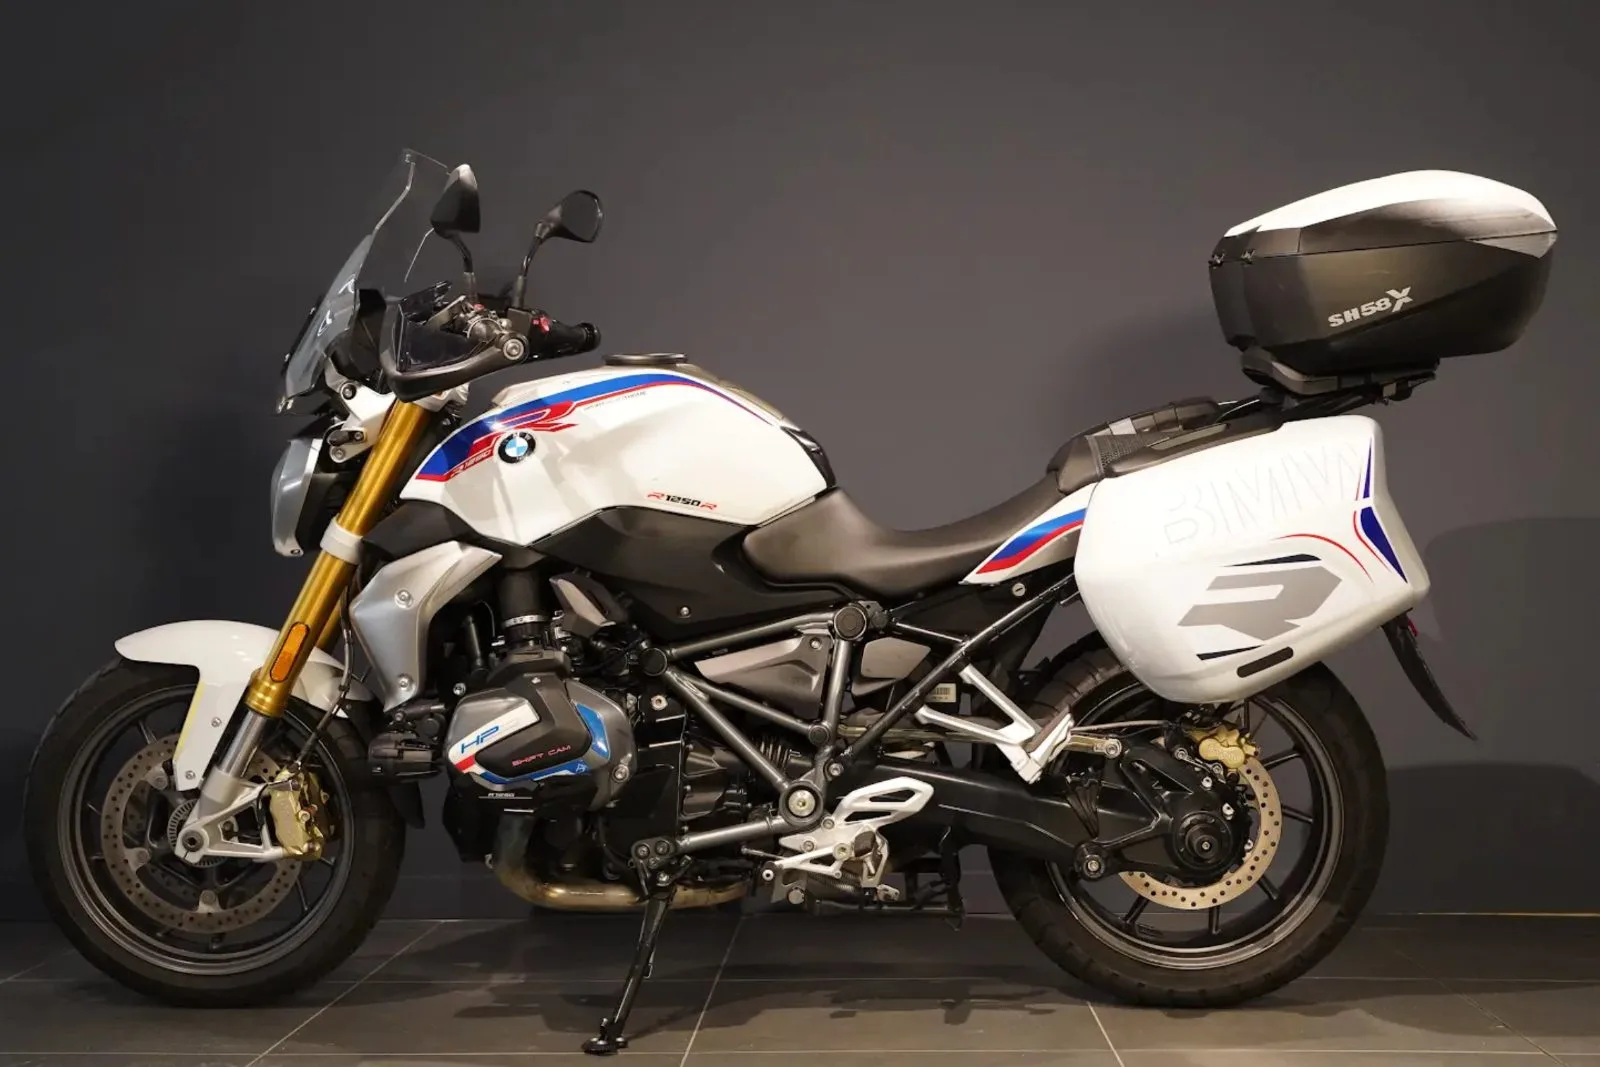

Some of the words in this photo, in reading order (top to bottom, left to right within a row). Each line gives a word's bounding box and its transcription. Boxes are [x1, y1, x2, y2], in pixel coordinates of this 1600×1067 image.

[1327, 286, 1413, 328] SH58X
[461, 726, 499, 753] HP
[547, 745, 571, 756] CAM
